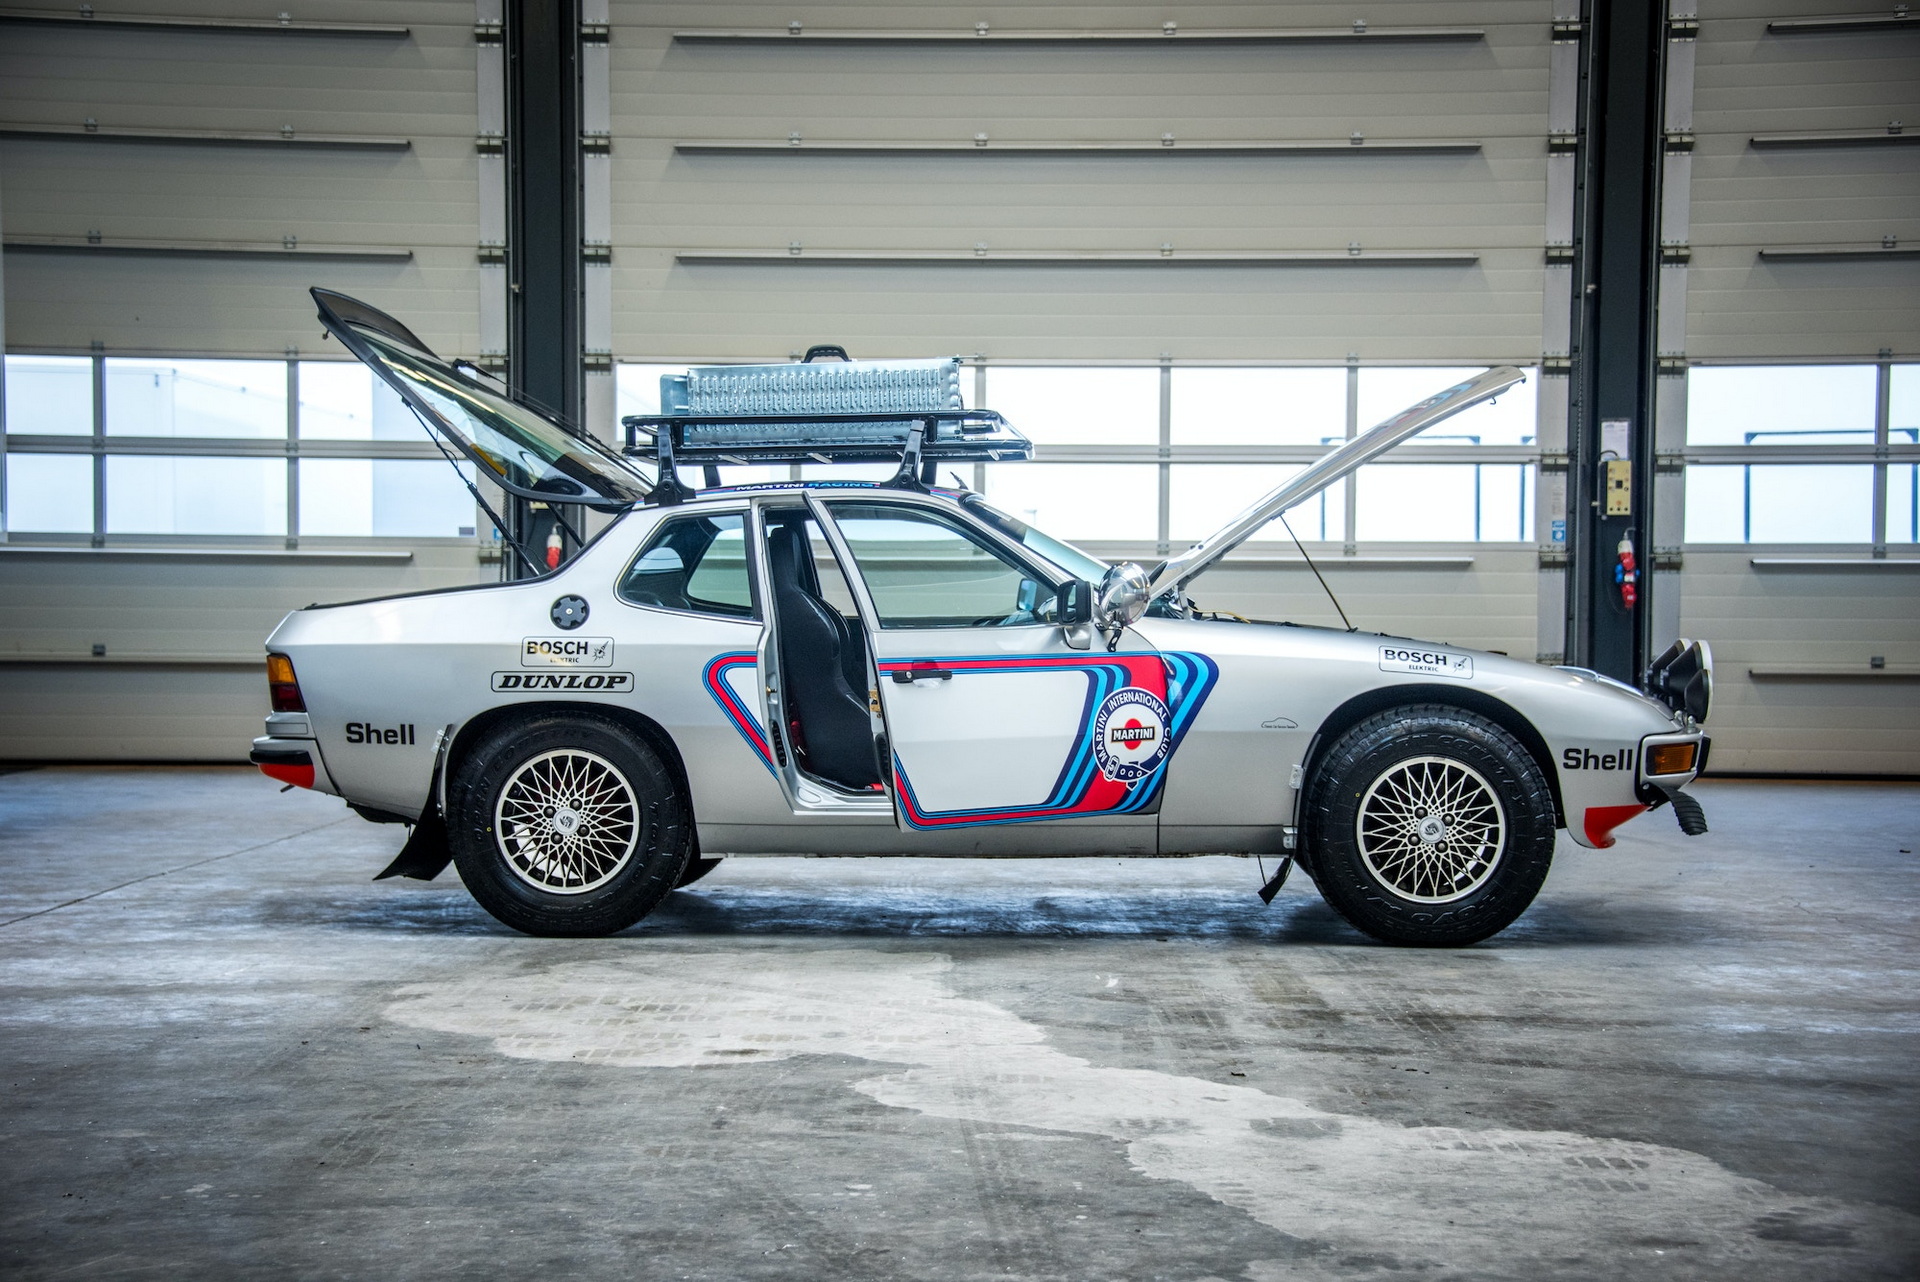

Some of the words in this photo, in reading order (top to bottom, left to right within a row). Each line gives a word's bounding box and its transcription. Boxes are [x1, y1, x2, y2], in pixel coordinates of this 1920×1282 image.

[736, 483, 805, 491] MARTINI
[527, 641, 589, 655] BOSCH
[1384, 649, 1447, 666] BOSCH
[1408, 664, 1439, 672] ELEKTRIC
[498, 675, 628, 689] DUNLOP
[345, 722, 415, 745] Shell
[1096, 709, 1108, 763] MARTINI
[1107, 691, 1168, 722] INTERNATIONAL
[1157, 727, 1171, 759] CLUB
[1113, 728, 1153, 740] MARTINI
[1562, 748, 1633, 771] Shell
